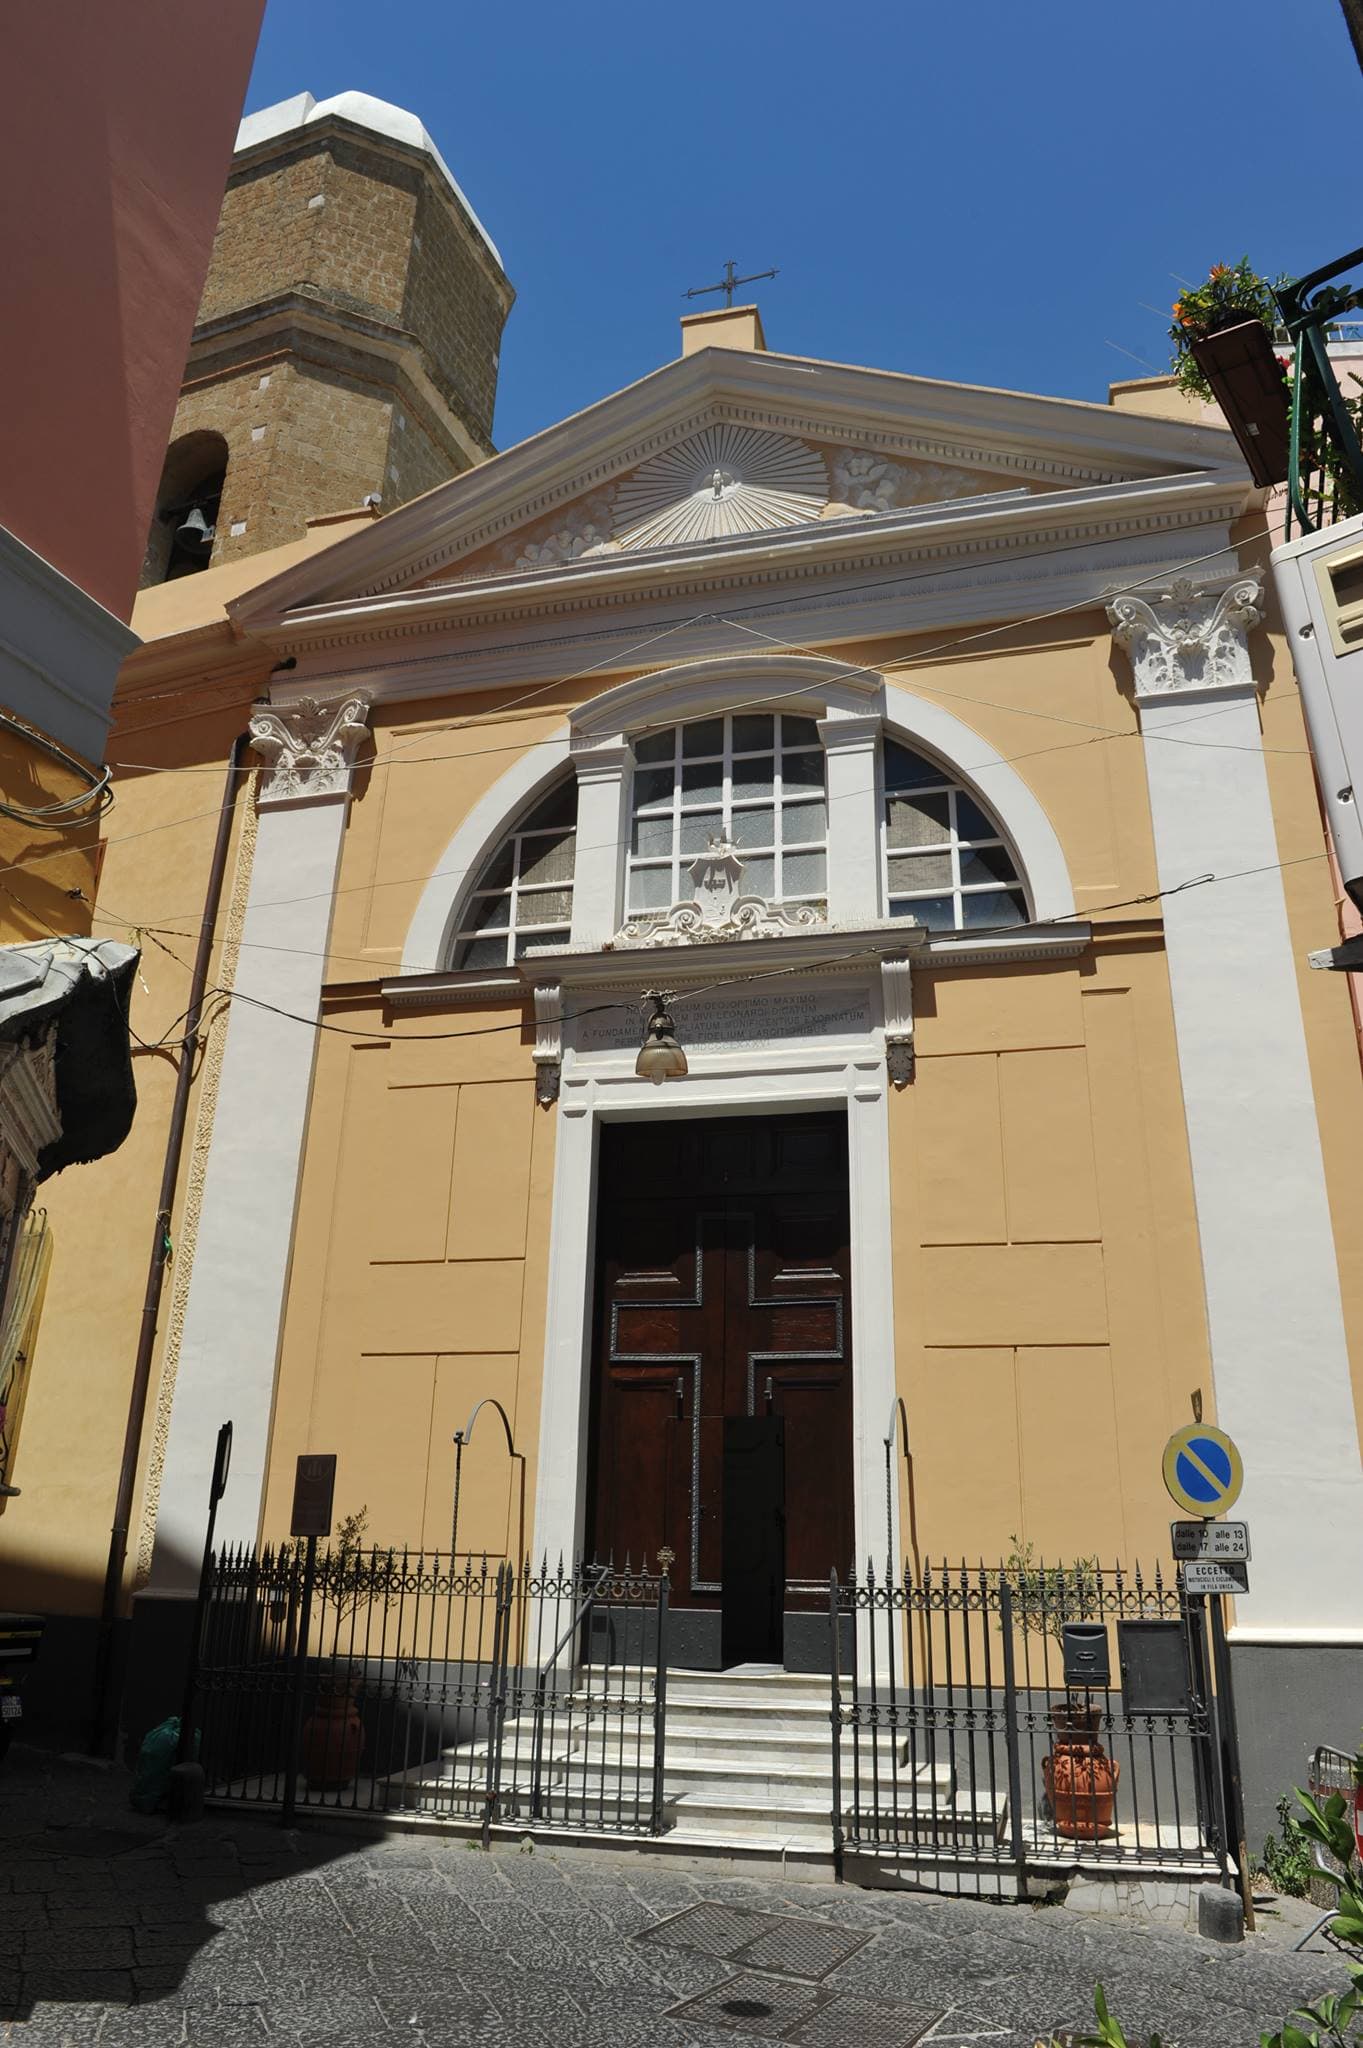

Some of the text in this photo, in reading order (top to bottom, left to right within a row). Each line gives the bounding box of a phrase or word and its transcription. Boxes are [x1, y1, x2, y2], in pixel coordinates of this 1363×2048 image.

[774, 994, 816, 1005] MAXIMO
[771, 1004, 817, 1016] DICATUM
[804, 1011, 865, 1024] EXORNATUM
[1175, 1529, 1243, 1539] dalle 10 alle 13
[1176, 1542, 1244, 1552] dalle 17 alle 24
[1196, 1566, 1235, 1576] ECCETTO
